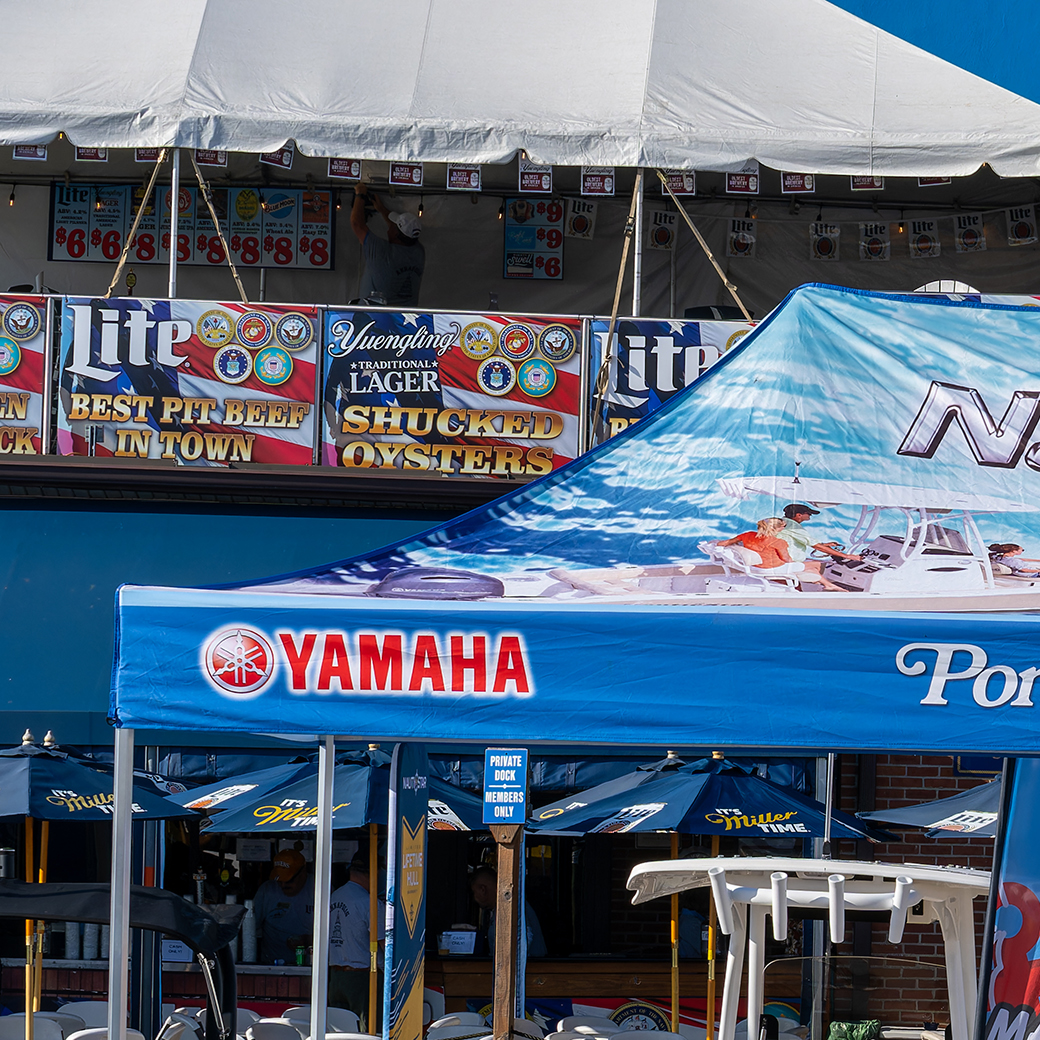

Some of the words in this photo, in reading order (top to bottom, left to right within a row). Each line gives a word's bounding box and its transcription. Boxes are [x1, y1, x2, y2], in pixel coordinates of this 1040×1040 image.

[57, 186, 89, 206] Lite
[571, 199, 594, 214] Lite
[536, 201, 563, 223] $9
[653, 211, 676, 226] Lite
[731, 219, 754, 233] Lite
[55, 226, 86, 258] $6
[91, 227, 121, 260] $6
[536, 227, 563, 249] $9
[231, 234, 260, 265] $8
[264, 234, 293, 265] $8
[300, 235, 329, 266] $8
[535, 256, 561, 278] $6
[65, 304, 193, 382] Lite
[327, 320, 461, 358] Yuengling
[358, 360, 432, 369] TRADITIONAL
[593, 331, 720, 409] Lite
[350, 371, 440, 394] LAGER
[68, 393, 154, 423] BEST
[160, 396, 216, 425] PIT
[223, 399, 310, 429] BEEF
[341, 405, 564, 440] SHUCKED
[114, 430, 152, 459] IN
[159, 431, 255, 462] TOWN
[341, 441, 554, 475] OYSTERS
[278, 632, 531, 694] YAMAHA
[490, 755, 522, 767] PRIVATE
[494, 769, 516, 781] DOCK
[51, 789, 78, 797] IT'S
[280, 798, 309, 808] IT'S
[485, 791, 524, 804] MEMBERS
[494, 805, 515, 818] ONLY
[704, 811, 798, 831] Miller
[715, 808, 743, 816] IT'S
